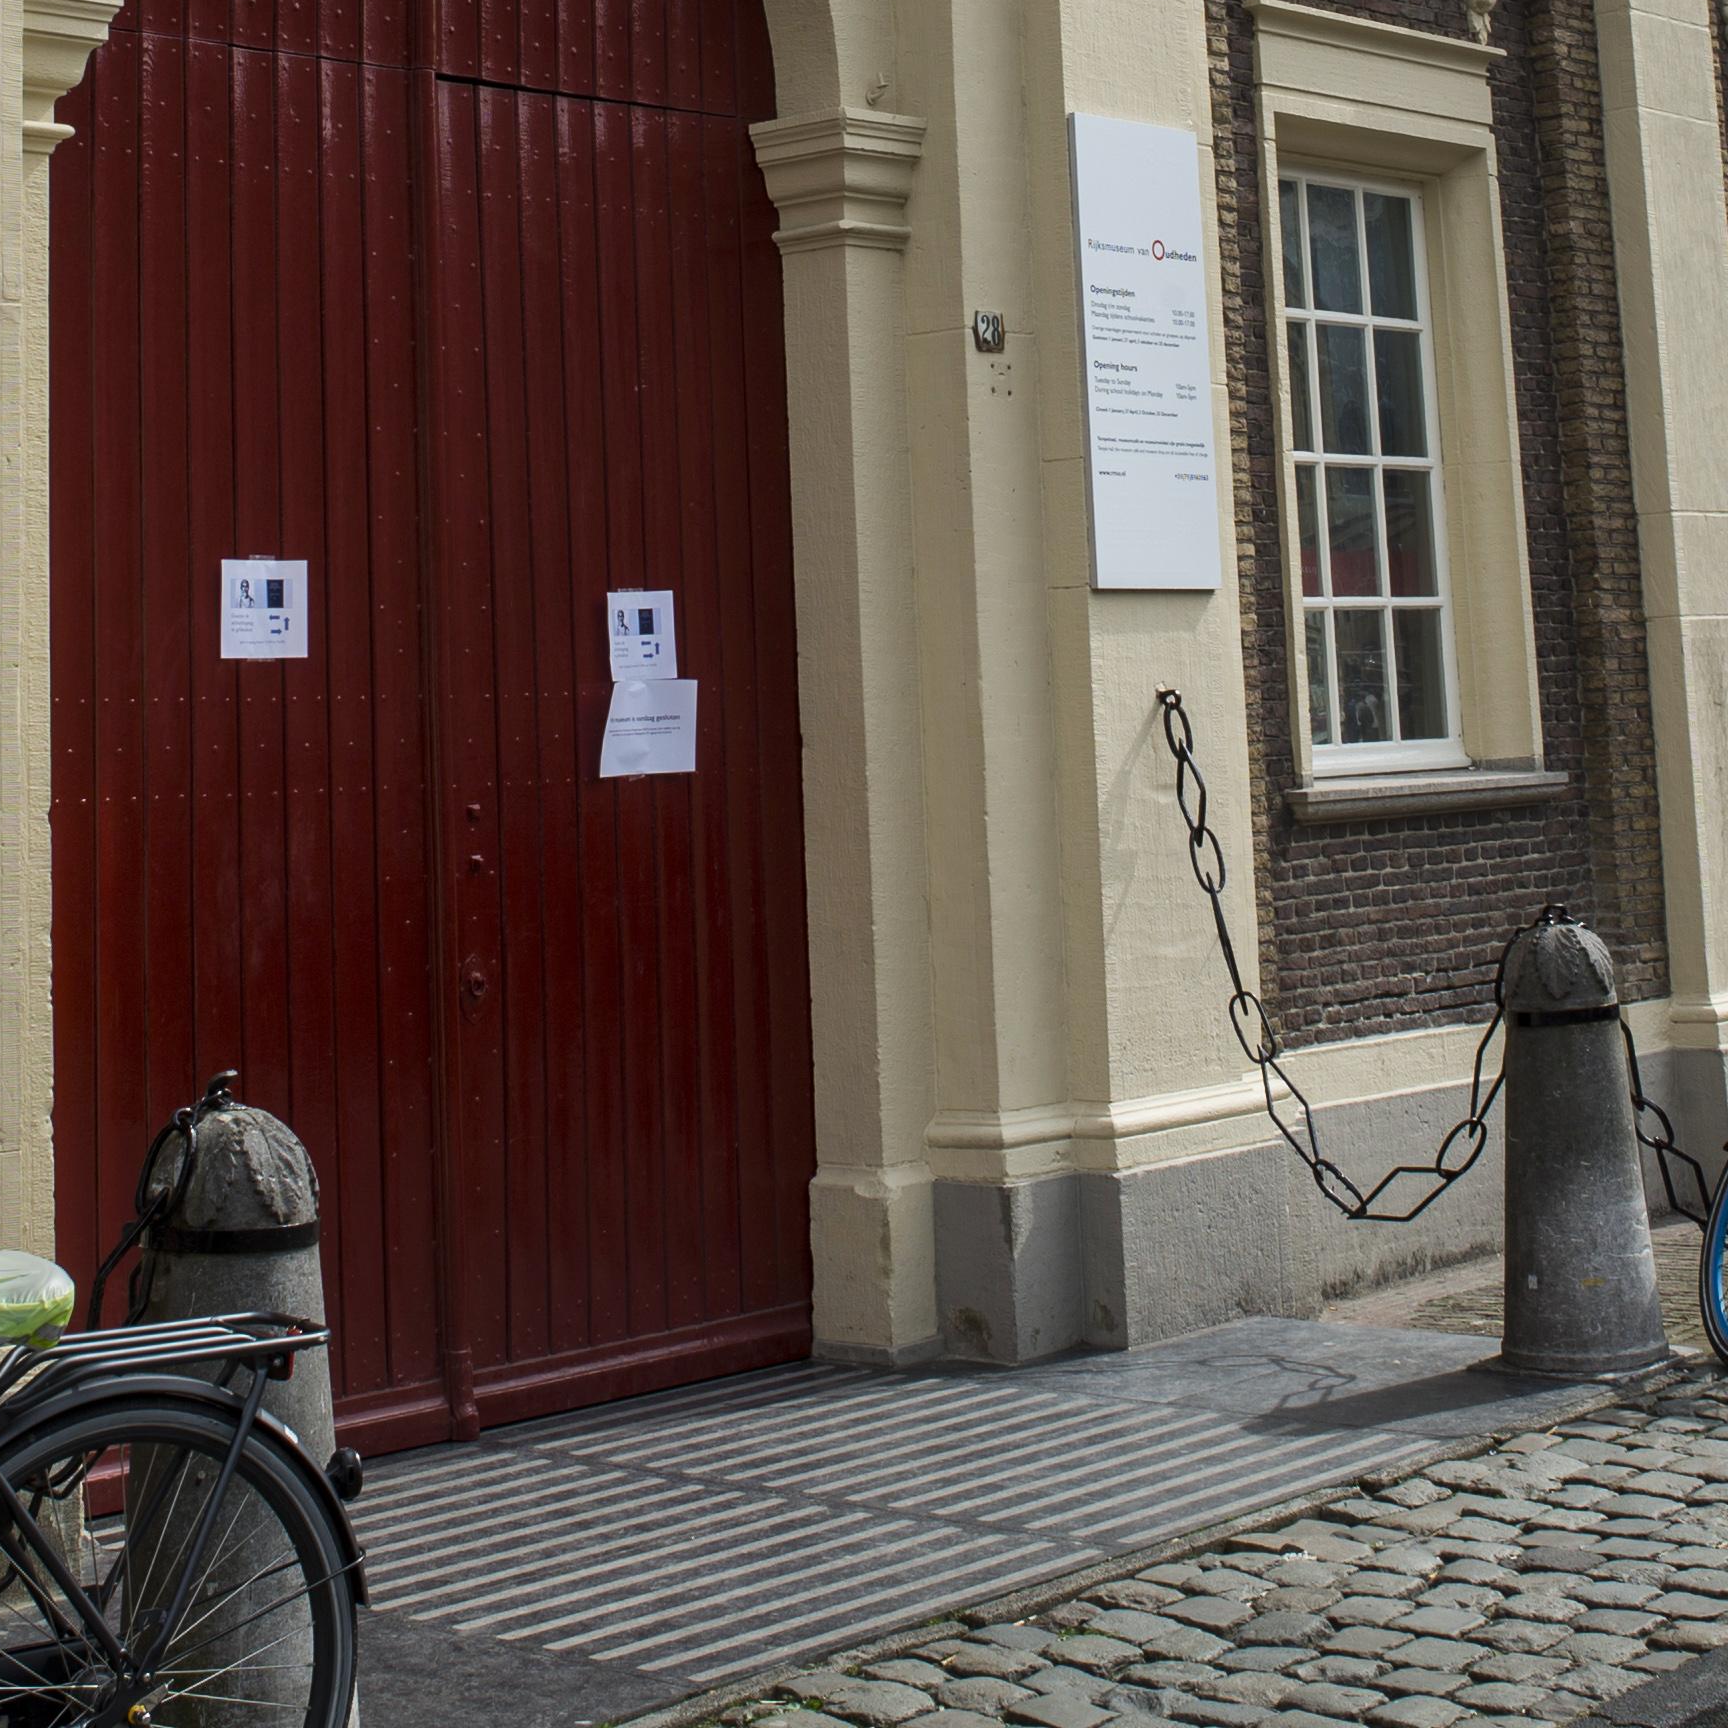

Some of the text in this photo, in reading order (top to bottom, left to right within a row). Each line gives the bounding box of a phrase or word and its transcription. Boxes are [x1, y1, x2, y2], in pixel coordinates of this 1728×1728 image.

[1088, 238, 1197, 262] Rijksmuseum van Oudheden
[1094, 360, 1138, 372] Opening hours
